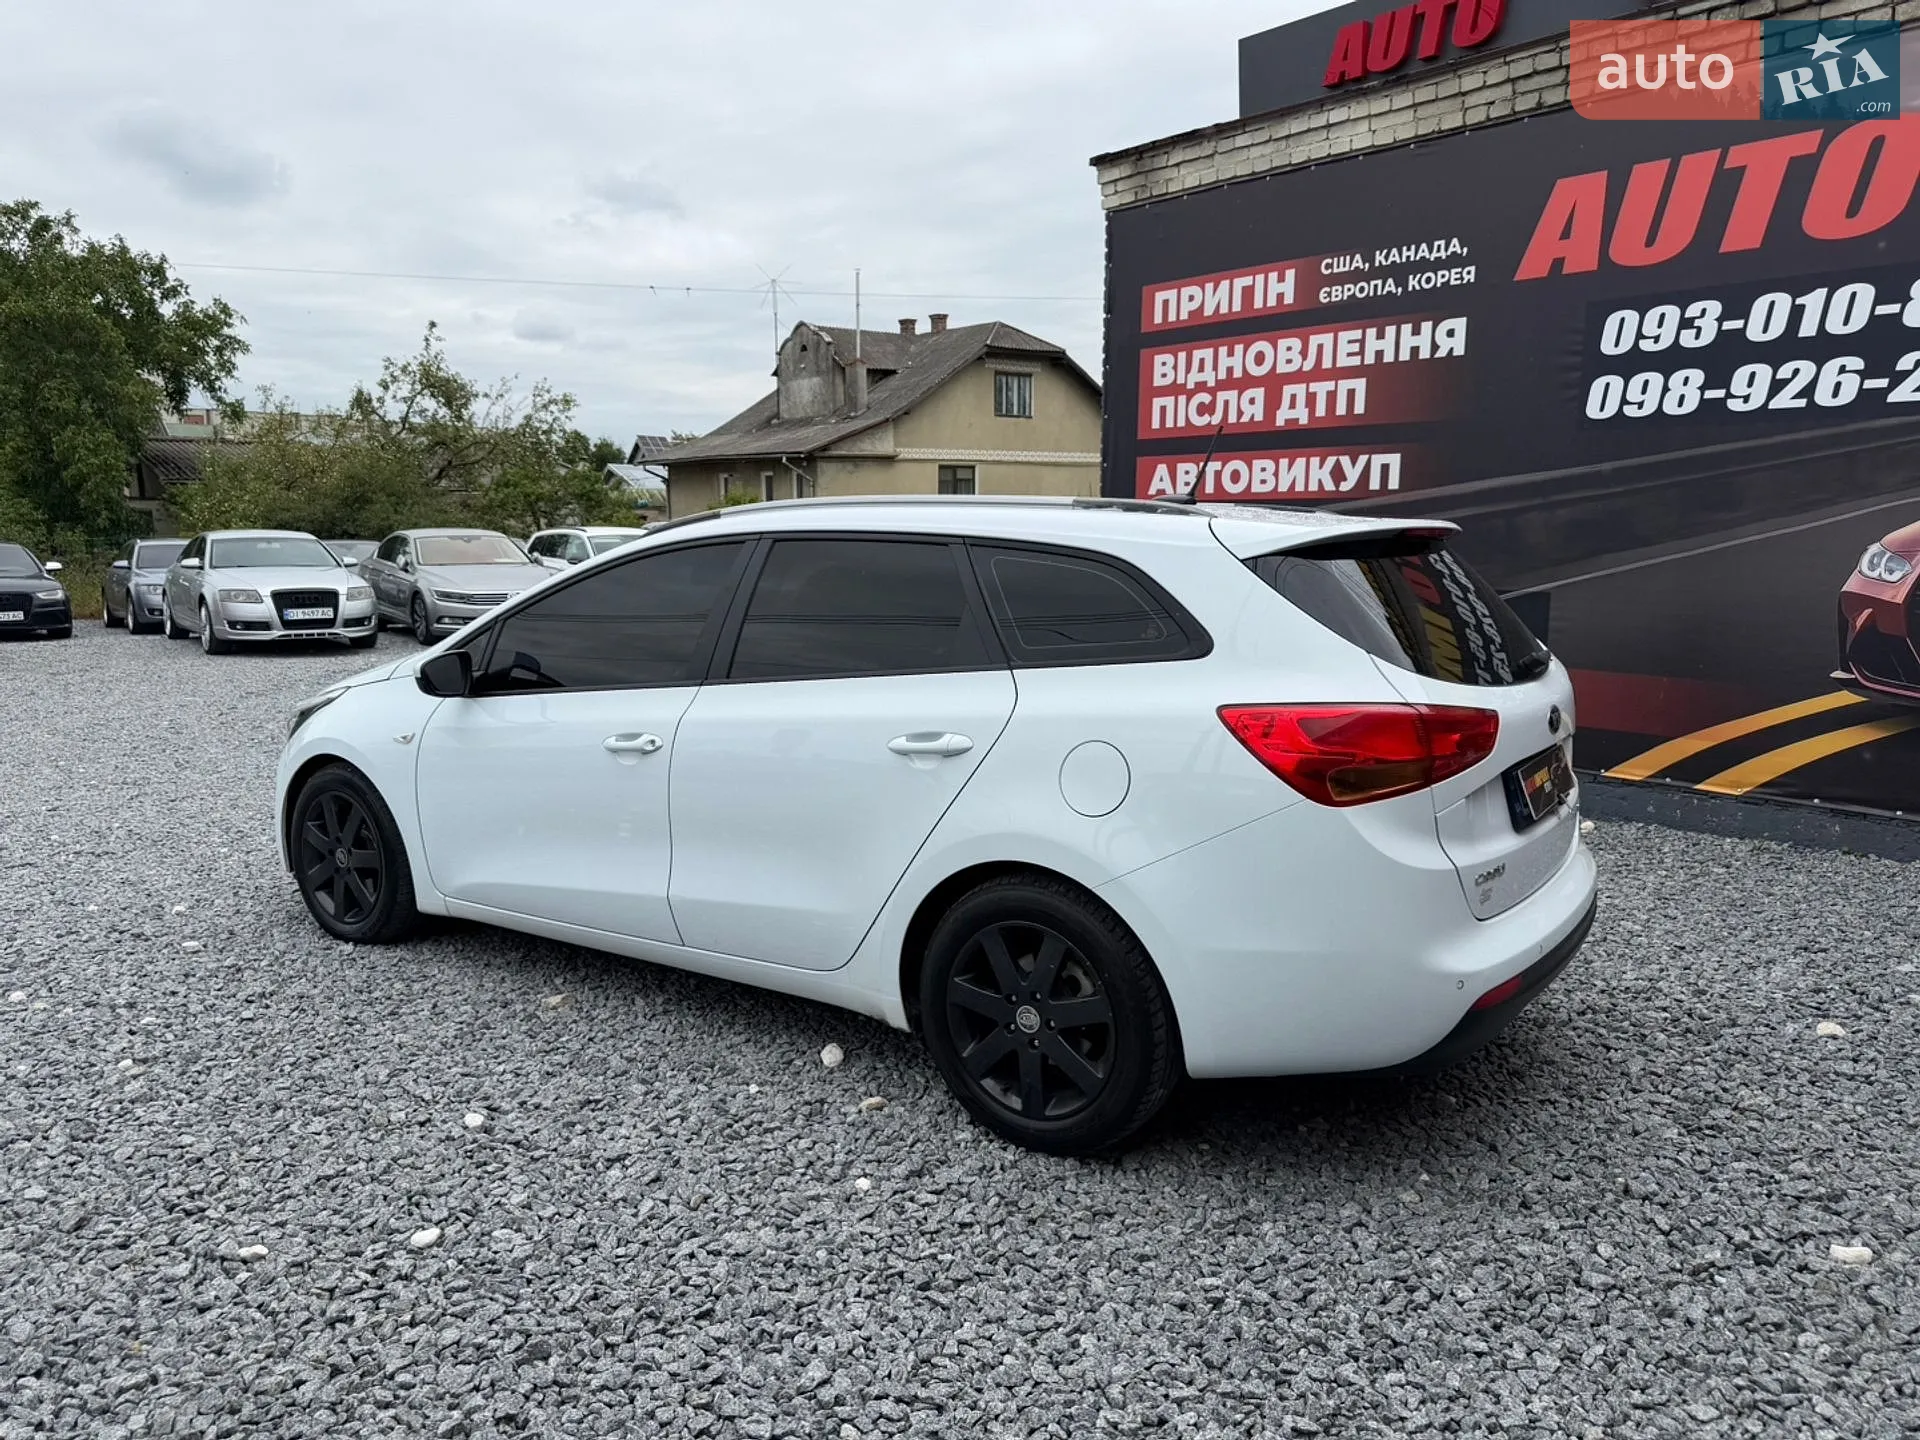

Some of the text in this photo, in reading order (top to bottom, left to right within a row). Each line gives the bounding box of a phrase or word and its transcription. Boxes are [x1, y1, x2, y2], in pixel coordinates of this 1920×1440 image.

[1322, 0, 1508, 88] AUTO
[1512, 112, 1920, 282] AUTO
[1320, 237, 1469, 275] США, КАНАДА,
[1153, 268, 1297, 325] ПРИГІН
[1319, 265, 1477, 304] ЄВРОПА, КОРЕЯ
[1152, 316, 1468, 389] ВІДНОВЛЕННЯ
[1151, 377, 1367, 430] ПІСЛЯ ДТП
[1147, 452, 1402, 496] АВТОВИКУП
